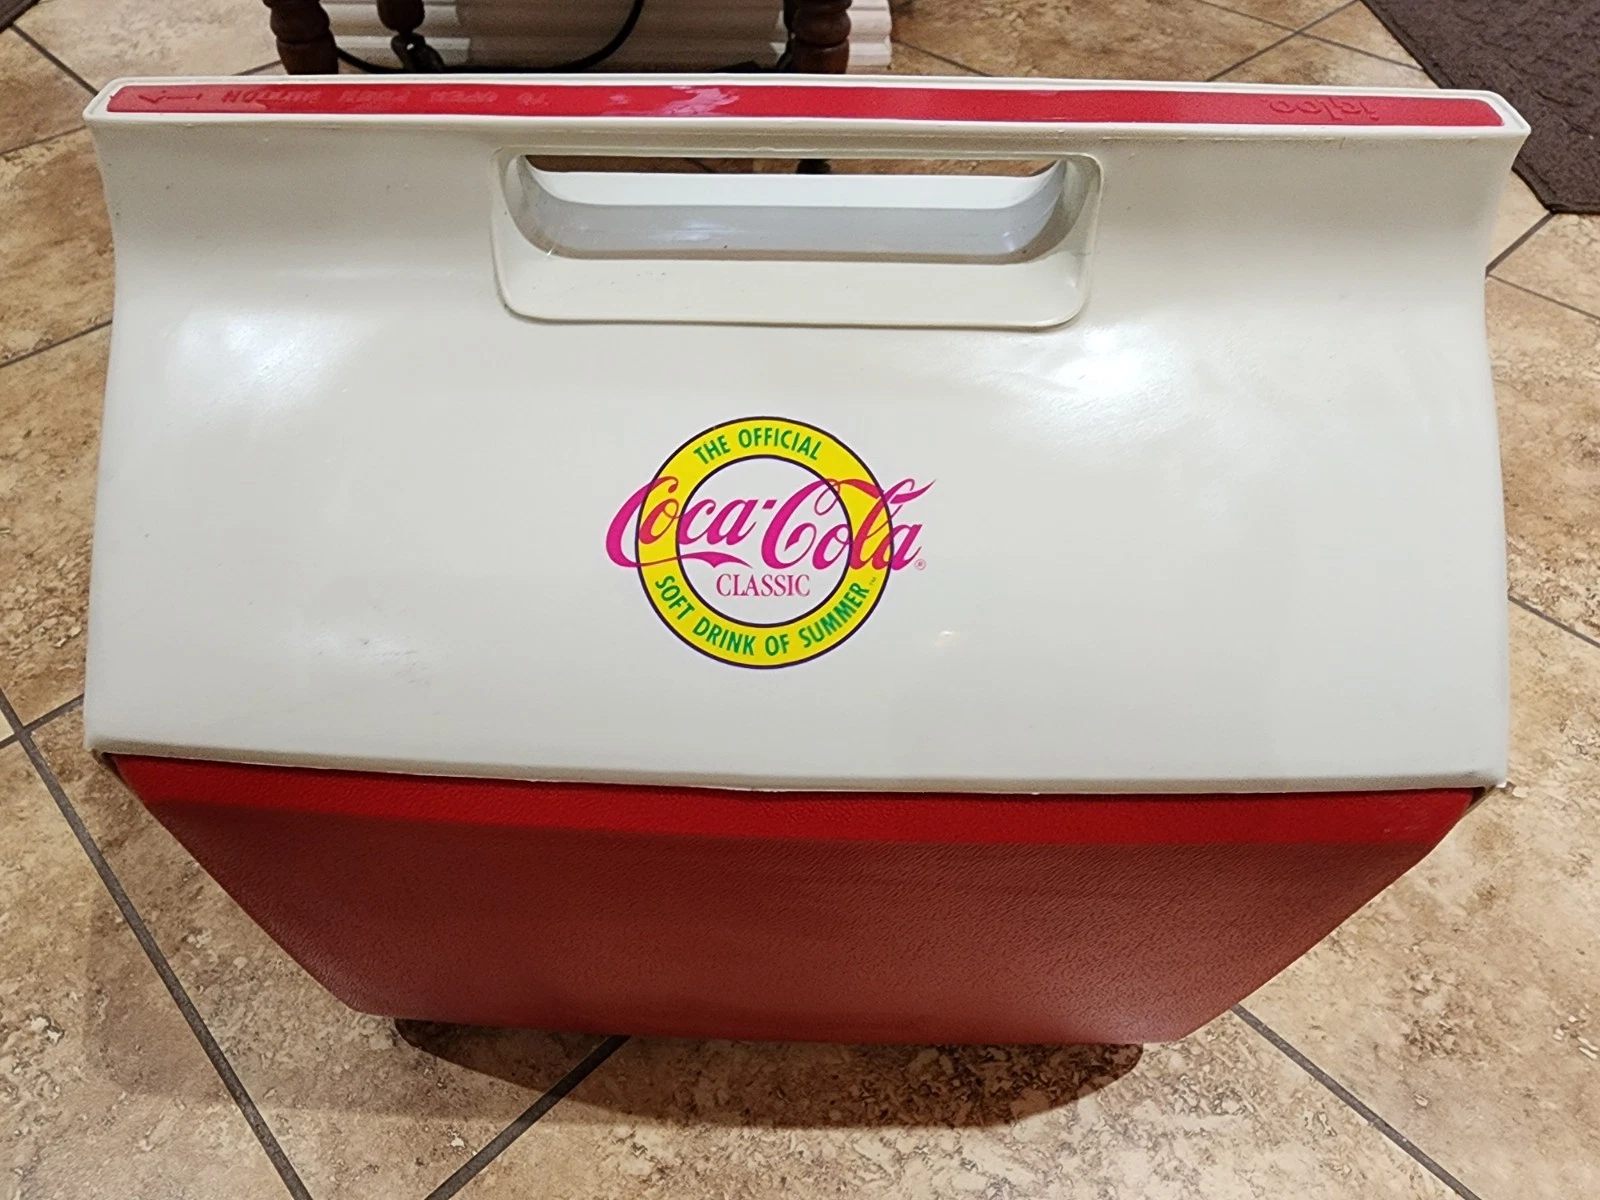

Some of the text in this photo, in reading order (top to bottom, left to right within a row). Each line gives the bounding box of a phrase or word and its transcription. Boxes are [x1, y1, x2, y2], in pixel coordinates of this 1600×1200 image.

[693, 427, 823, 465] THE OFFICIAL
[605, 475, 937, 571] Coca-Cola
[716, 573, 810, 597] CLASSIC
[655, 575, 695, 621] SOFT
[692, 616, 756, 656] DRINK
[765, 633, 791, 657] OF
[798, 582, 870, 649] SUMMER
